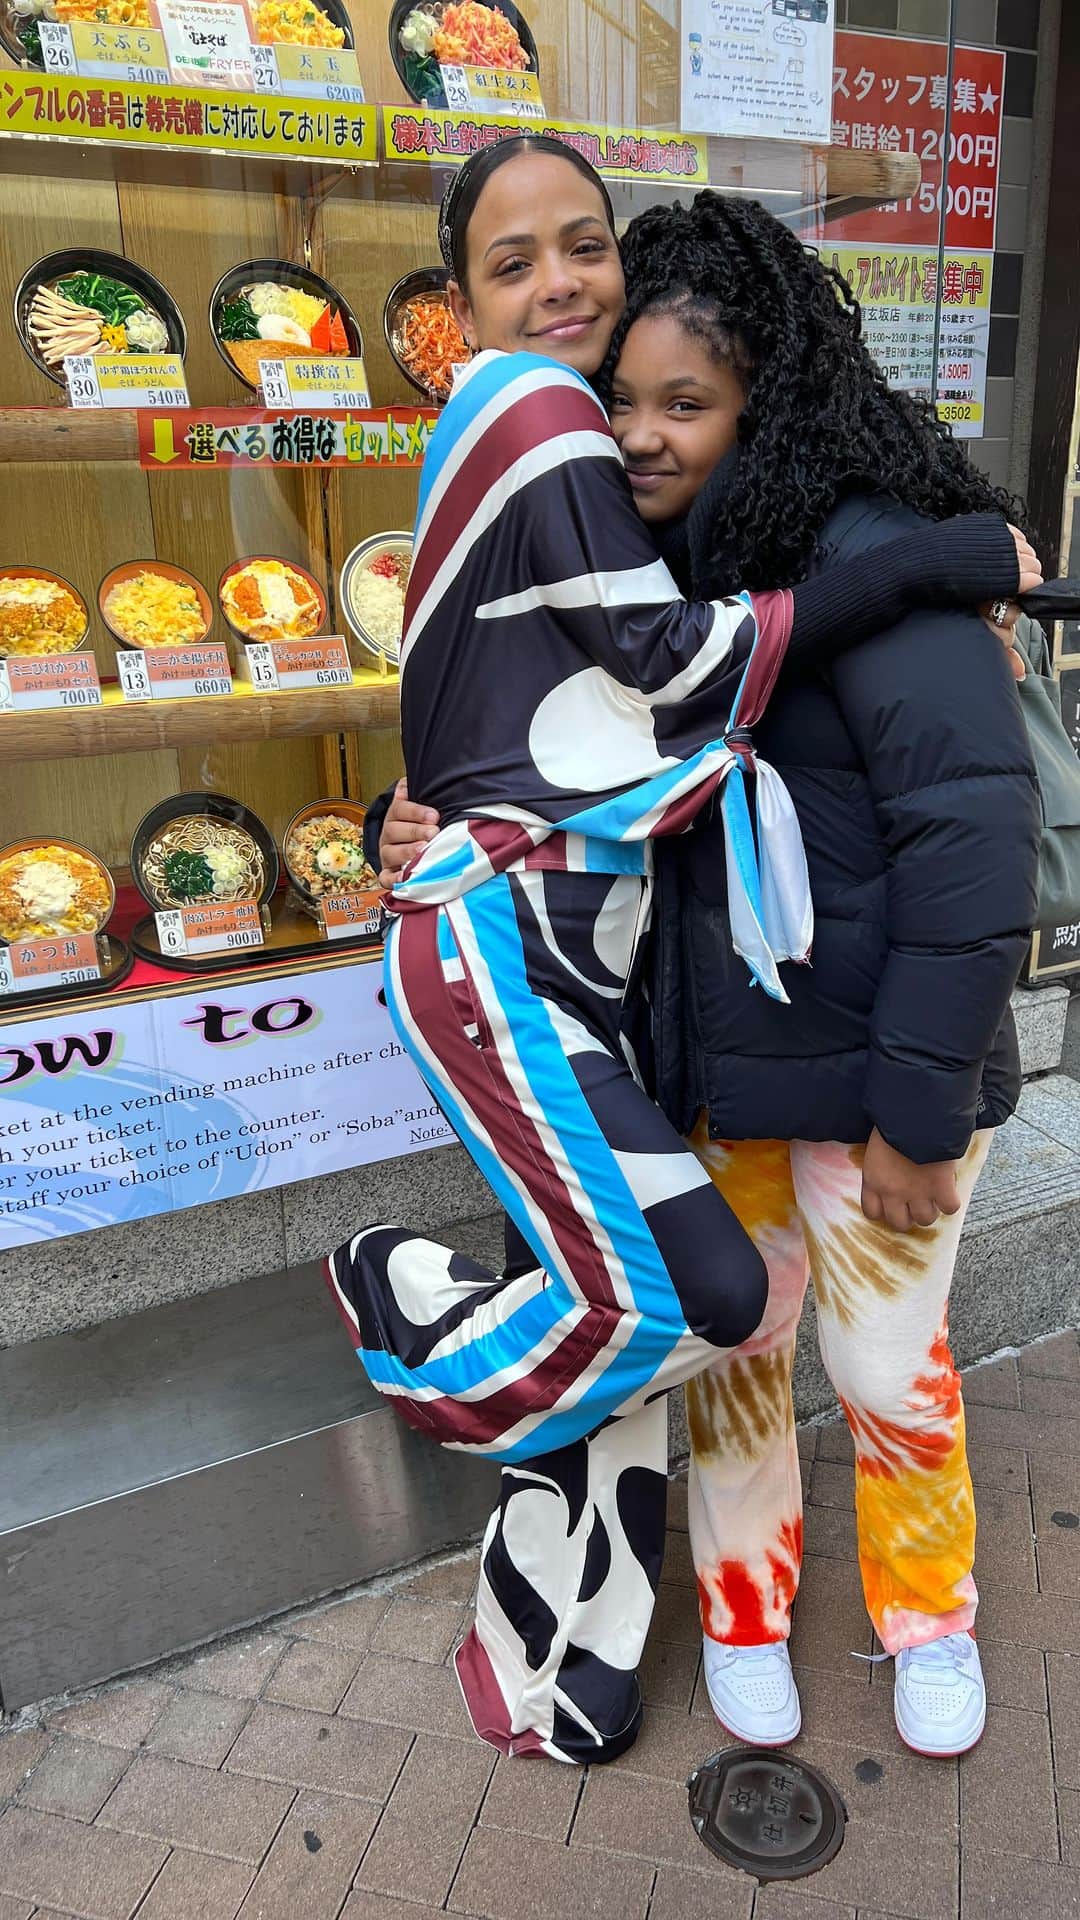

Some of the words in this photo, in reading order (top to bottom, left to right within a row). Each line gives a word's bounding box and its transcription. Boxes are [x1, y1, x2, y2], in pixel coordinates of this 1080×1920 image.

[47, 48, 69, 68] 26
[209, 58, 252, 72] FRYER
[127, 66, 170, 85] 540円
[255, 70, 275, 86] 27
[325, 85, 363, 104] 620円
[447, 86, 469, 103] 28
[73, 379, 94, 398] 30
[266, 382, 284, 399] 31
[147, 390, 188, 405] 540円
[332, 392, 369, 408] 540円
[125, 671, 145, 690] 13
[254, 665, 272, 682] 15
[316, 669, 350, 684] 650円
[194, 678, 231, 695] 660円
[59, 688, 100, 705] 700円
[167, 931, 177, 946] 6
[226, 930, 262, 947] 900円
[21, 941, 78, 963] かつ丼
[60, 969, 98, 986] 550円
[183, 998, 314, 1043] to
[40, 1112, 66, 1129] at
[73, 1103, 113, 1122] the
[120, 1084, 215, 1112] vending
[223, 1062, 317, 1092] machine
[323, 1050, 374, 1070] after
[22, 1136, 79, 1162] your
[87, 1119, 162, 1145] ticket.
[409, 1123, 449, 1143] Note:
[26, 1162, 81, 1188] your
[90, 1144, 158, 1169] ticket
[165, 1138, 188, 1153] to
[195, 1128, 231, 1147] the
[238, 1108, 325, 1137] counter.
[56, 1179, 111, 1206] your
[119, 1163, 191, 1188] choice
[198, 1151, 221, 1170] of
[309, 1129, 331, 1145] or
